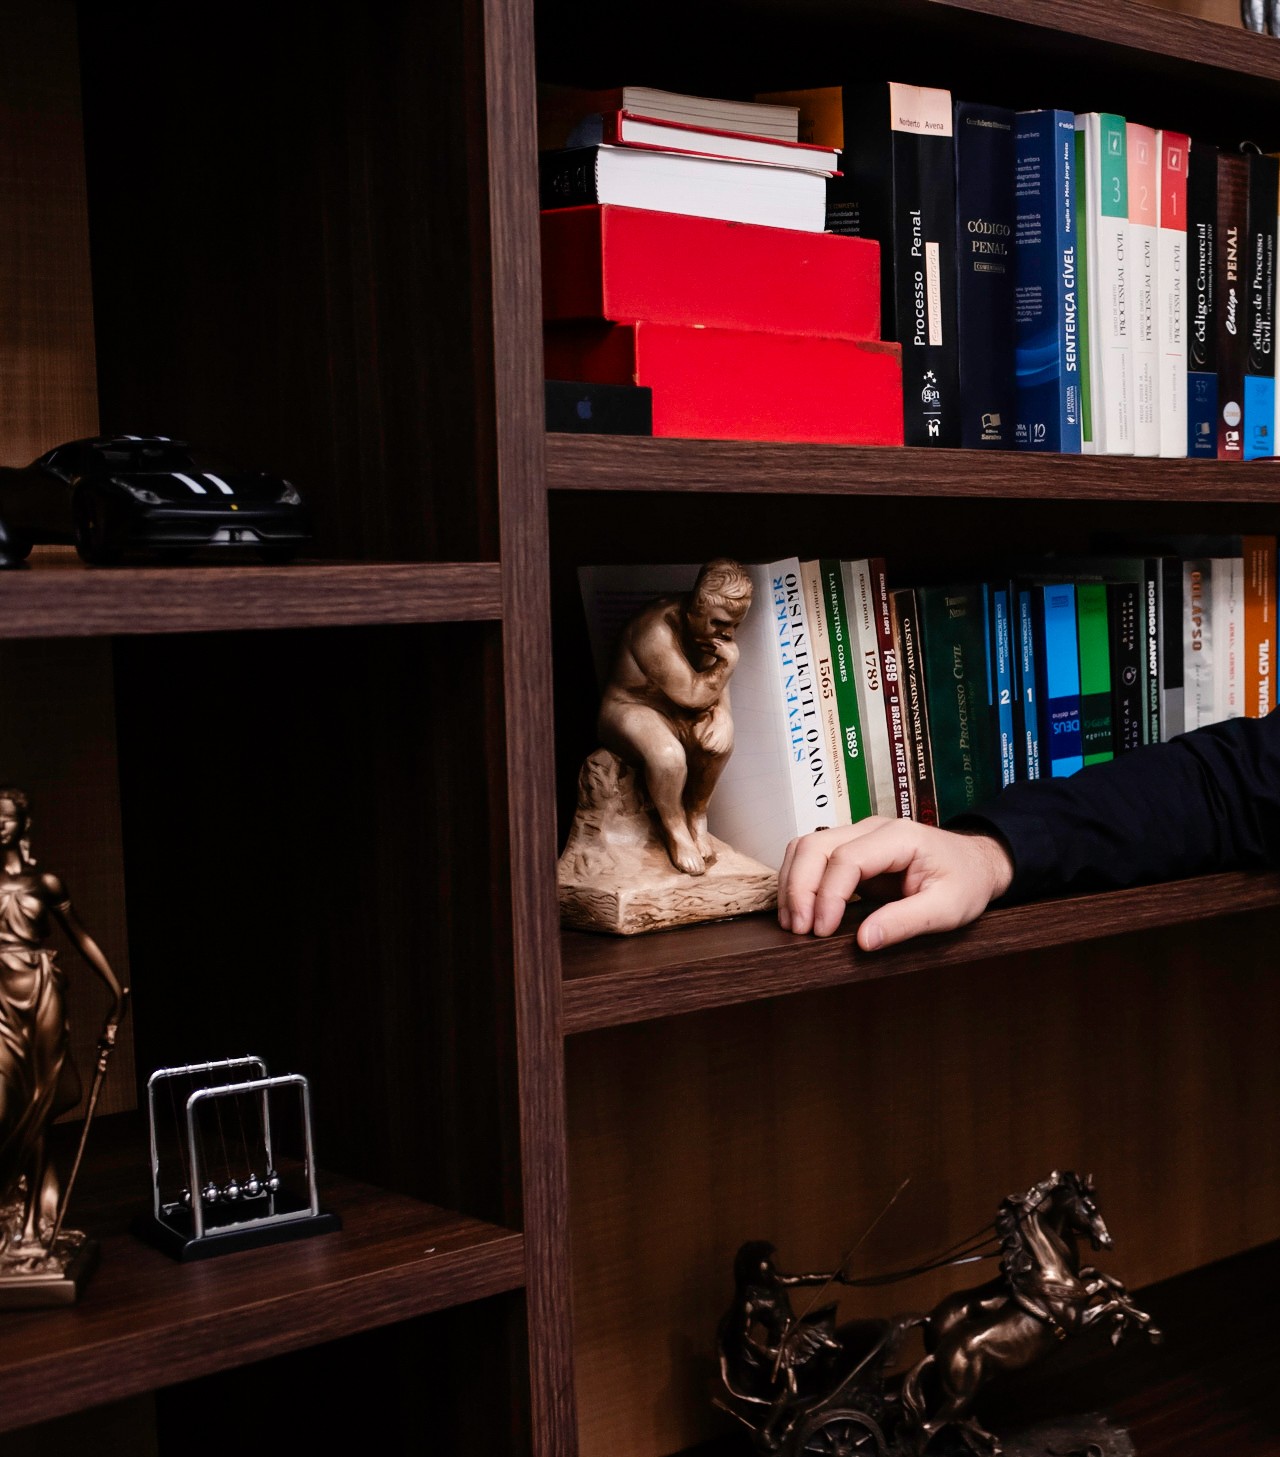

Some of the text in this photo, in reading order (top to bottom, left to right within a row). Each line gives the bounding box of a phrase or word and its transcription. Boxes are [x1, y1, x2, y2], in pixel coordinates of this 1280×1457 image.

[899, 117, 944, 130] Norberto Avena
[1112, 176, 1121, 203] 3
[1140, 185, 1148, 211] 2
[1171, 191, 1177, 216] 1
[967, 218, 1011, 236] CÓDIGO
[971, 240, 1008, 256] PENAL
[1173, 243, 1181, 272] CIVIL
[1196, 223, 1206, 291] Comercial
[1252, 233, 1264, 290] Processo
[909, 209, 926, 346] Processo Penal
[1116, 231, 1126, 336] PROCESSUAL CIVIL
[1226, 226, 1239, 336] Código PENAL
[1062, 246, 1078, 372] SENTENÇA CÍVEL
[1252, 293, 1263, 310] de
[1189, 294, 1208, 369] Código
[1262, 320, 1272, 354] Civil
[1033, 423, 1046, 438] 10
[812, 579, 823, 638] PEDRO DORIA
[859, 573, 870, 630] PEDRO DORIA
[882, 601, 890, 616] JOSÉ
[1147, 580, 1156, 635] RODRIGO
[1190, 570, 1203, 652] COLAPSO
[828, 573, 848, 683] LAURENTINO GOMES
[883, 616, 891, 635] LOPES
[773, 576, 806, 763] STEVEN PINKER
[864, 650, 879, 691] 1789
[883, 648, 898, 682] 1499
[1149, 637, 1158, 677] JANOT
[1258, 639, 1270, 675] CIVIL
[784, 573, 829, 808] O NOVO ILUMINISMO
[819, 658, 833, 699] 1565
[1026, 687, 1033, 703] 1
[1150, 679, 1158, 711] NADA
[903, 618, 927, 780] FELIPE FERNÁNDEZ-ARMESTO
[952, 644, 973, 772] DE PROCESSO CIVIL
[1000, 689, 1010, 705] 2
[890, 705, 902, 741] BRASIL
[845, 725, 859, 758] 1889
[894, 742, 906, 774] ANTES
[1001, 732, 1009, 758] DIREITO
[898, 775, 908, 789] DE
